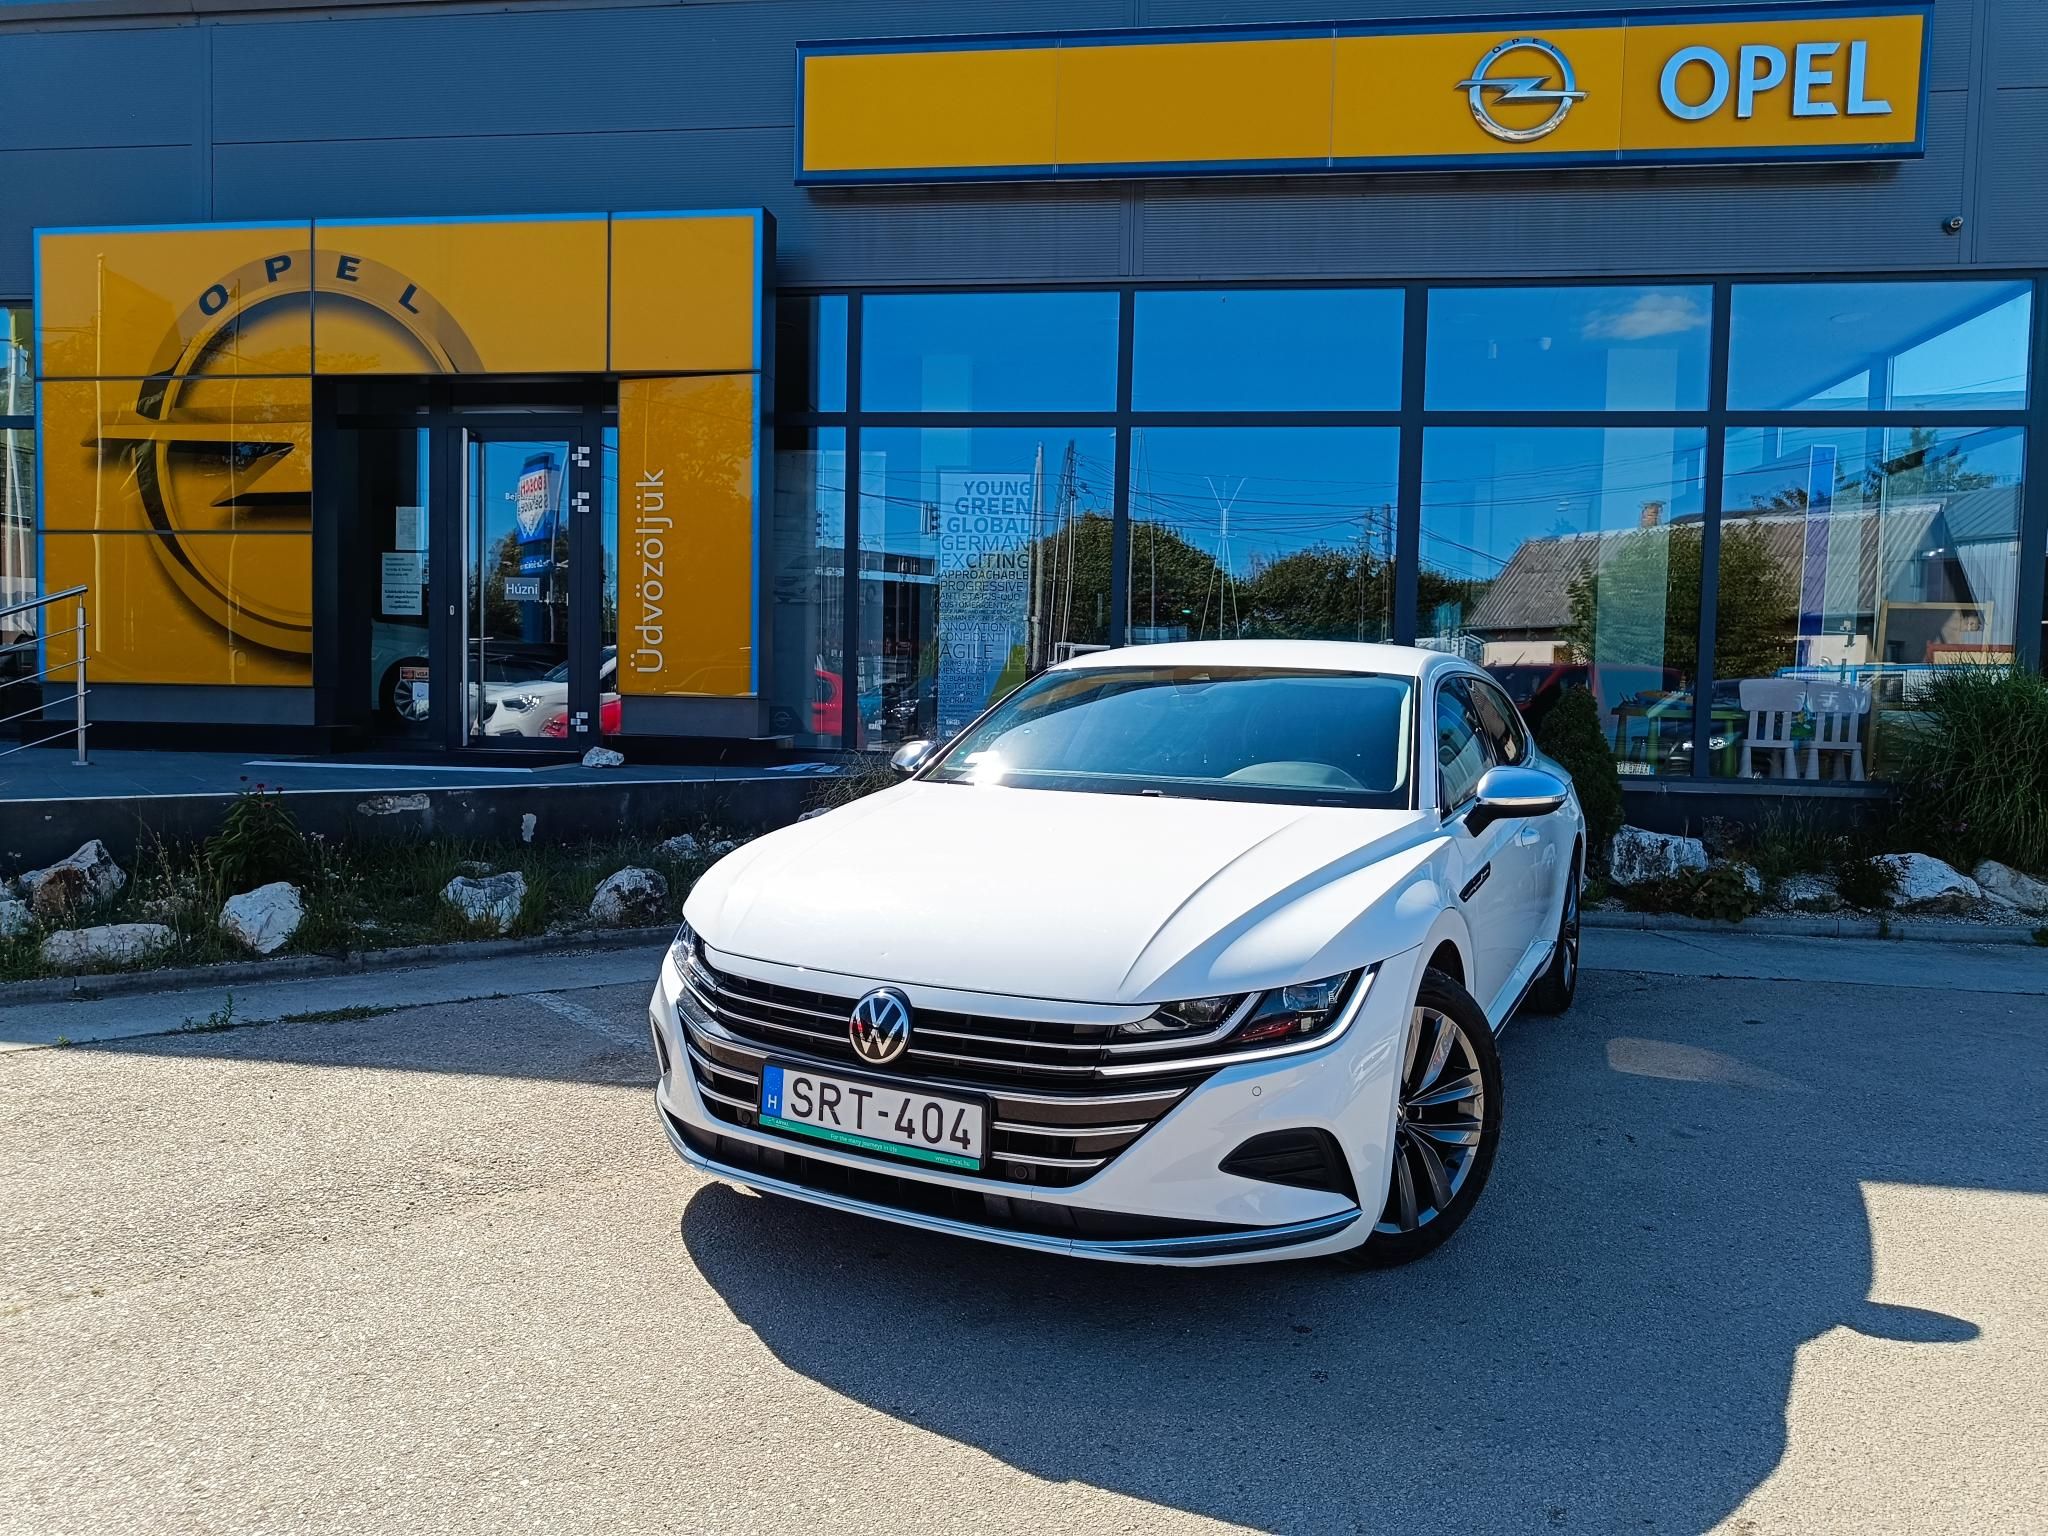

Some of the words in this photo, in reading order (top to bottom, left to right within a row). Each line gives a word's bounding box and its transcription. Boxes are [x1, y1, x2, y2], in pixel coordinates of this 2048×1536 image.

[1659, 40, 1893, 121] OPEL
[199, 254, 420, 317] OPEL
[964, 480, 1030, 496] YOUNG
[954, 497, 1030, 515] GREEN
[946, 516, 1030, 534] GLOBAL
[941, 535, 1029, 552] GERMAN
[941, 553, 1029, 569] EXCITING
[630, 469, 673, 673] Üdvözöljük
[940, 570, 1028, 580] APPROACHABLE
[506, 583, 539, 596] Húzni
[940, 580, 1024, 592] PROGRESSIVE
[940, 622, 1006, 632] INNOVATION
[940, 632, 1004, 642] CONFIDENT
[939, 643, 994, 660] AGILE
[768, 1094, 778, 1110] H
[790, 1077, 971, 1150] SRT-404
[860, 1140, 883, 1150] journeys
